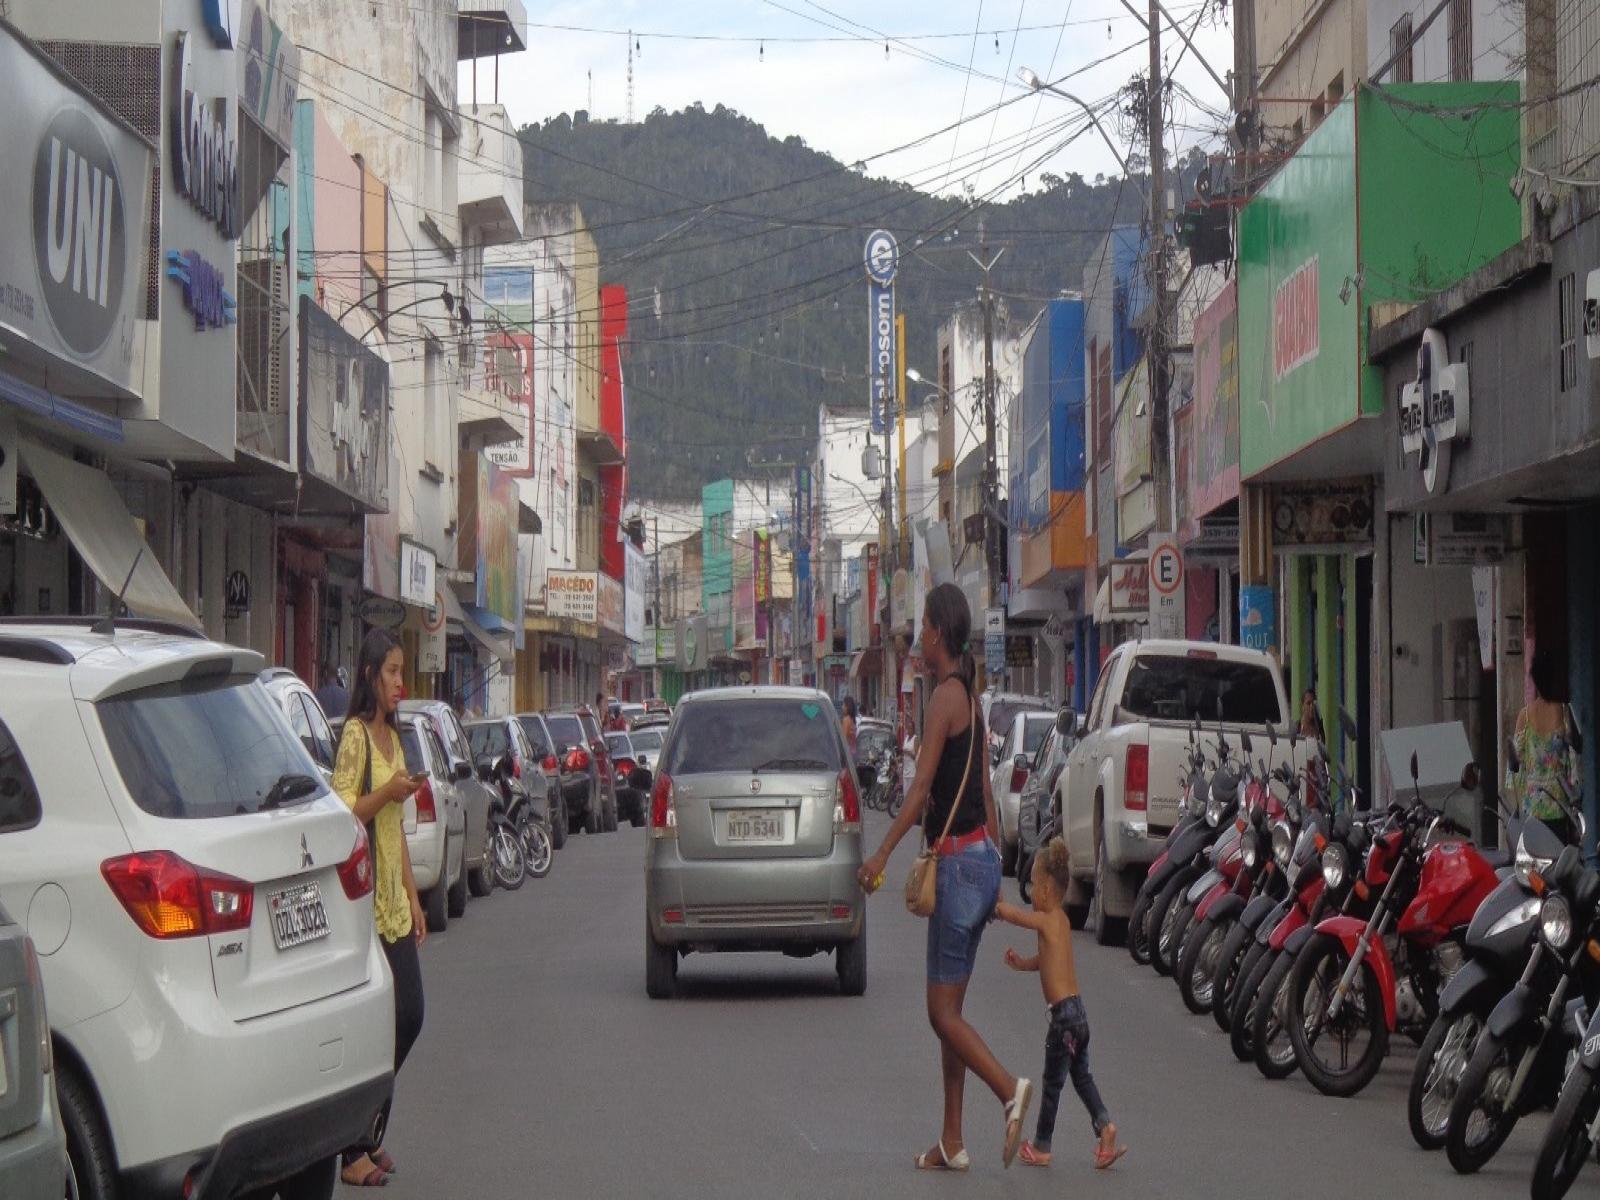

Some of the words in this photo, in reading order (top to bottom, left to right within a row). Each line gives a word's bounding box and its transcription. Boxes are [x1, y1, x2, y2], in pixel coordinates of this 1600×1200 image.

[47, 135, 114, 309] UNI
[1272, 253, 1320, 382] GUAIBIM
[1160, 555, 1173, 582] E
[1160, 597, 1174, 606] Em
